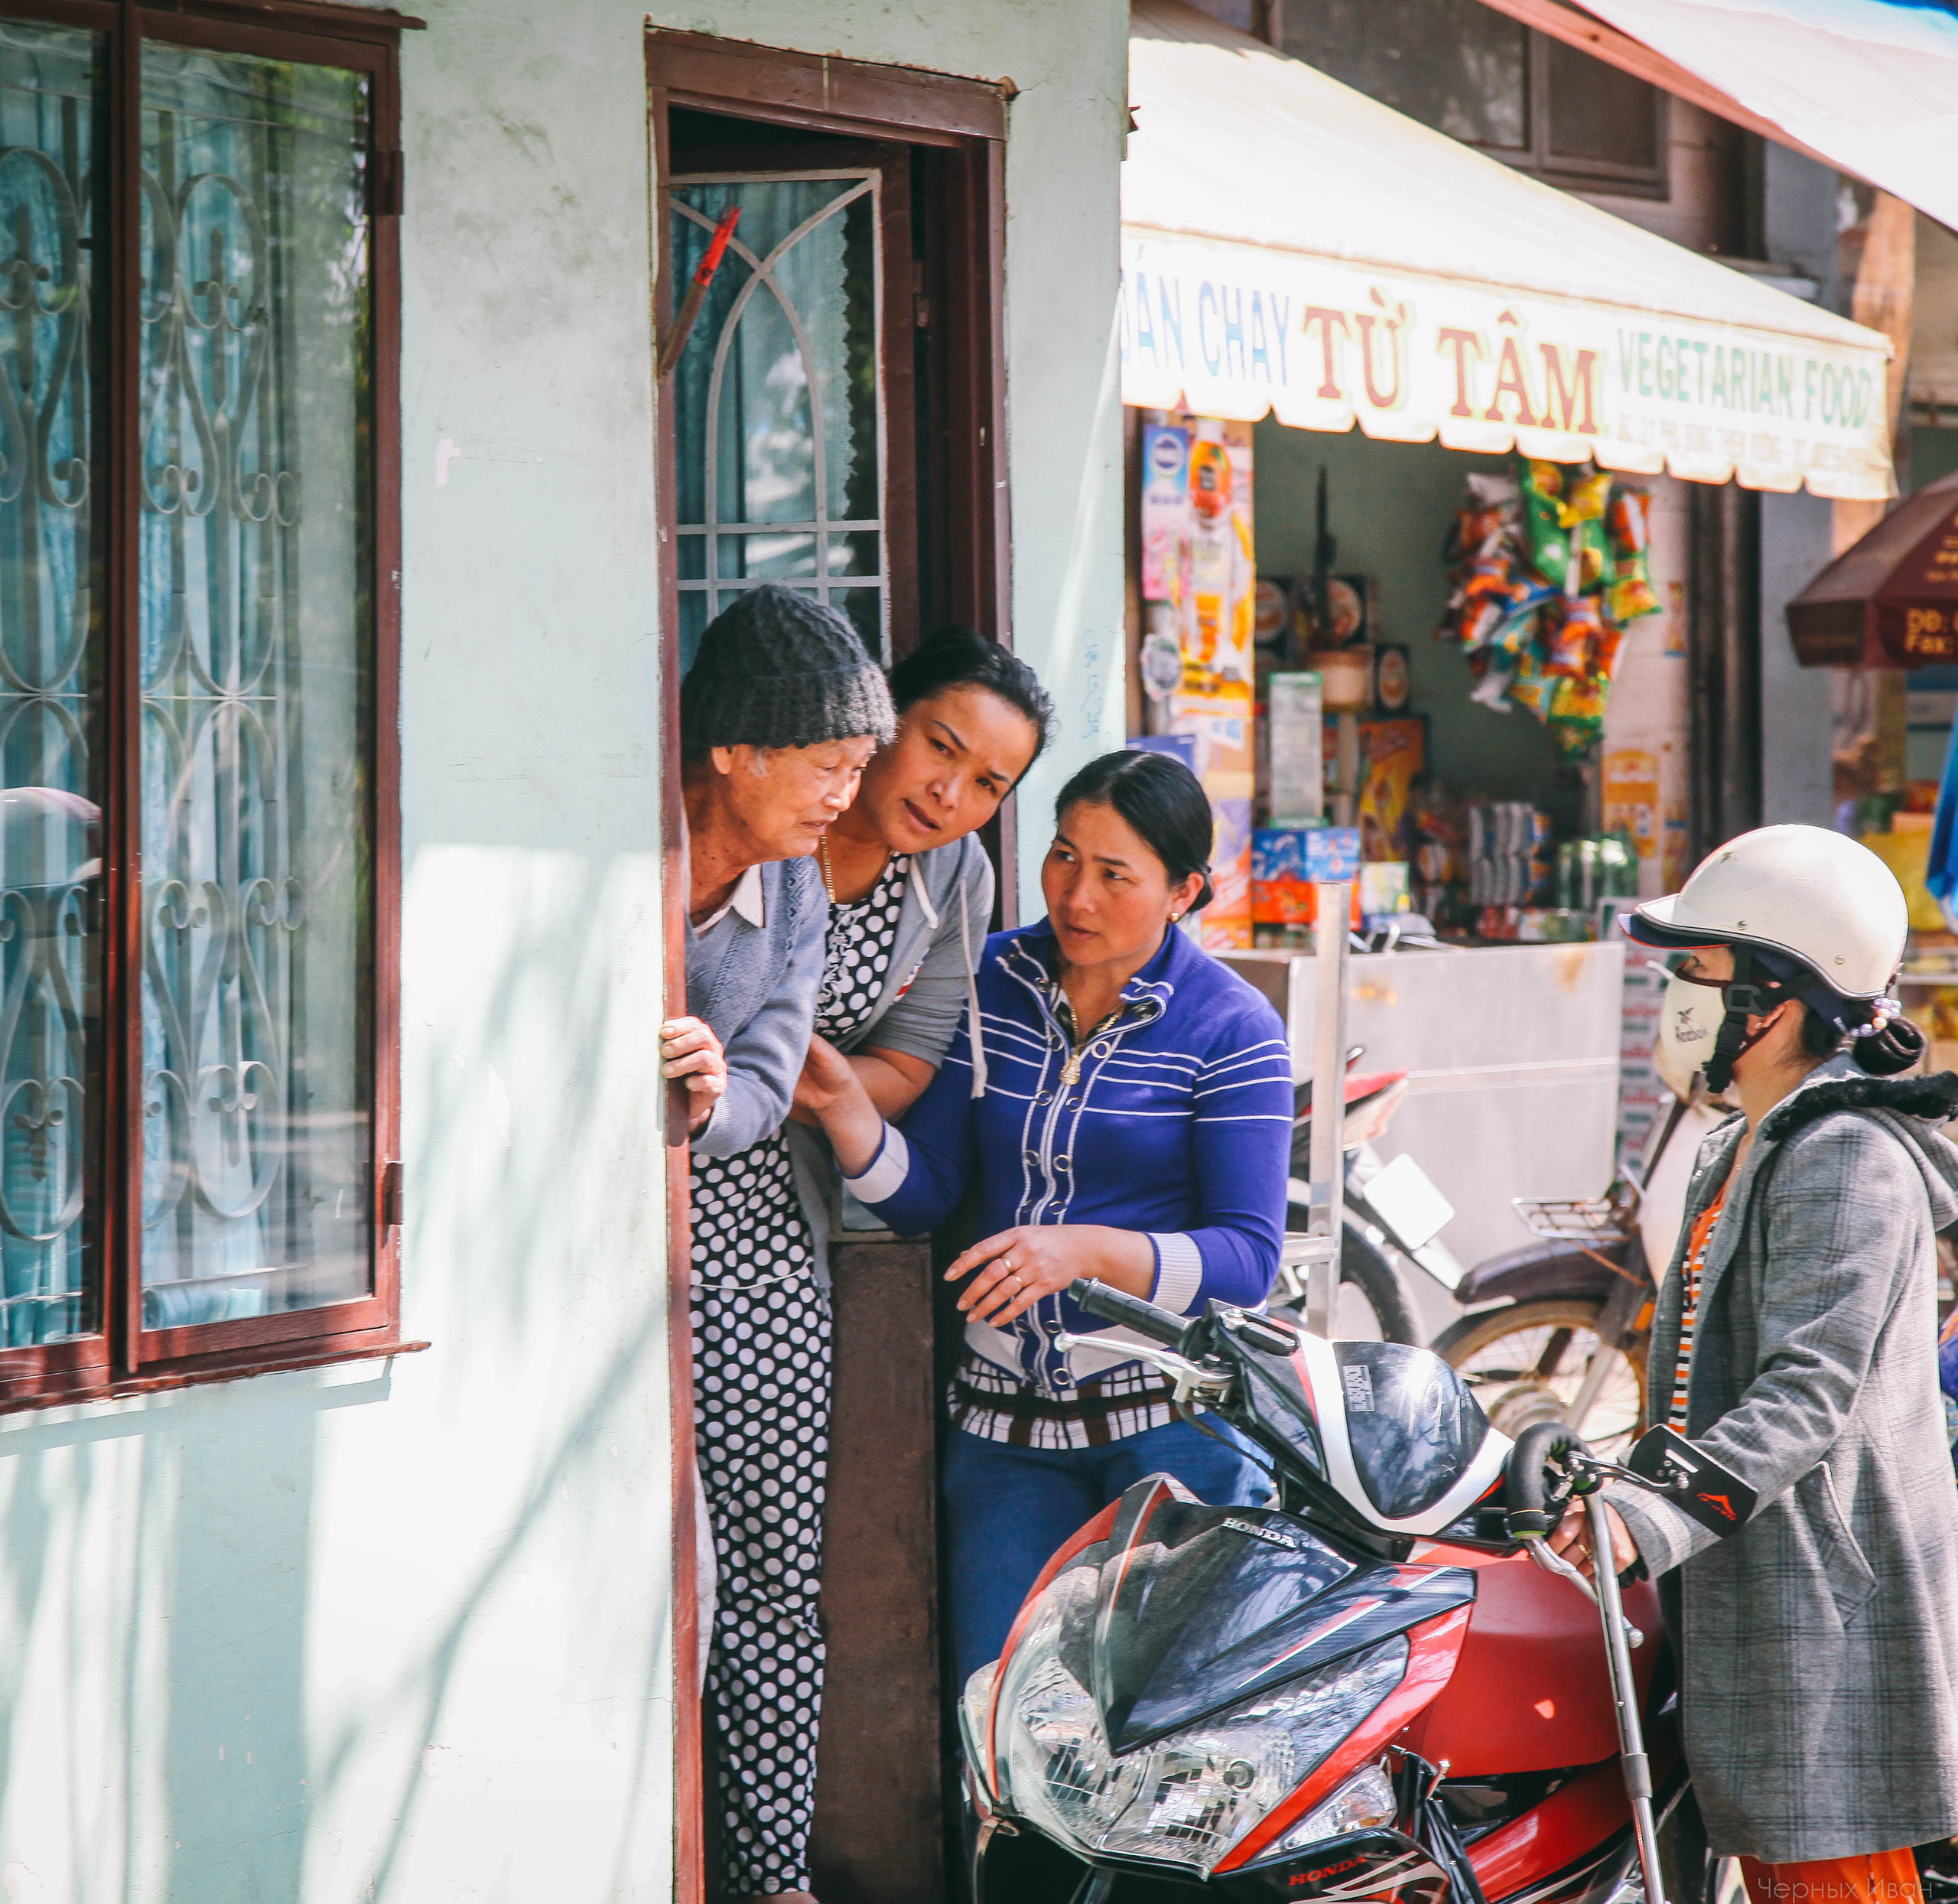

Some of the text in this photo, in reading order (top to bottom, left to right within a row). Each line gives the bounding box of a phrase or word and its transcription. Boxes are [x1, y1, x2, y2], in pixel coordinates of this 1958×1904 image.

[1199, 280, 1290, 386] CHAY
[1303, 286, 1406, 408] TỪ
[1436, 309, 1599, 435] TÂM
[1617, 327, 1794, 418] VEGETARIAN
[1806, 359, 1872, 428] FOOD
[1221, 1518, 1296, 1548] HONDA
[1288, 1856, 1368, 1886] HONDA
